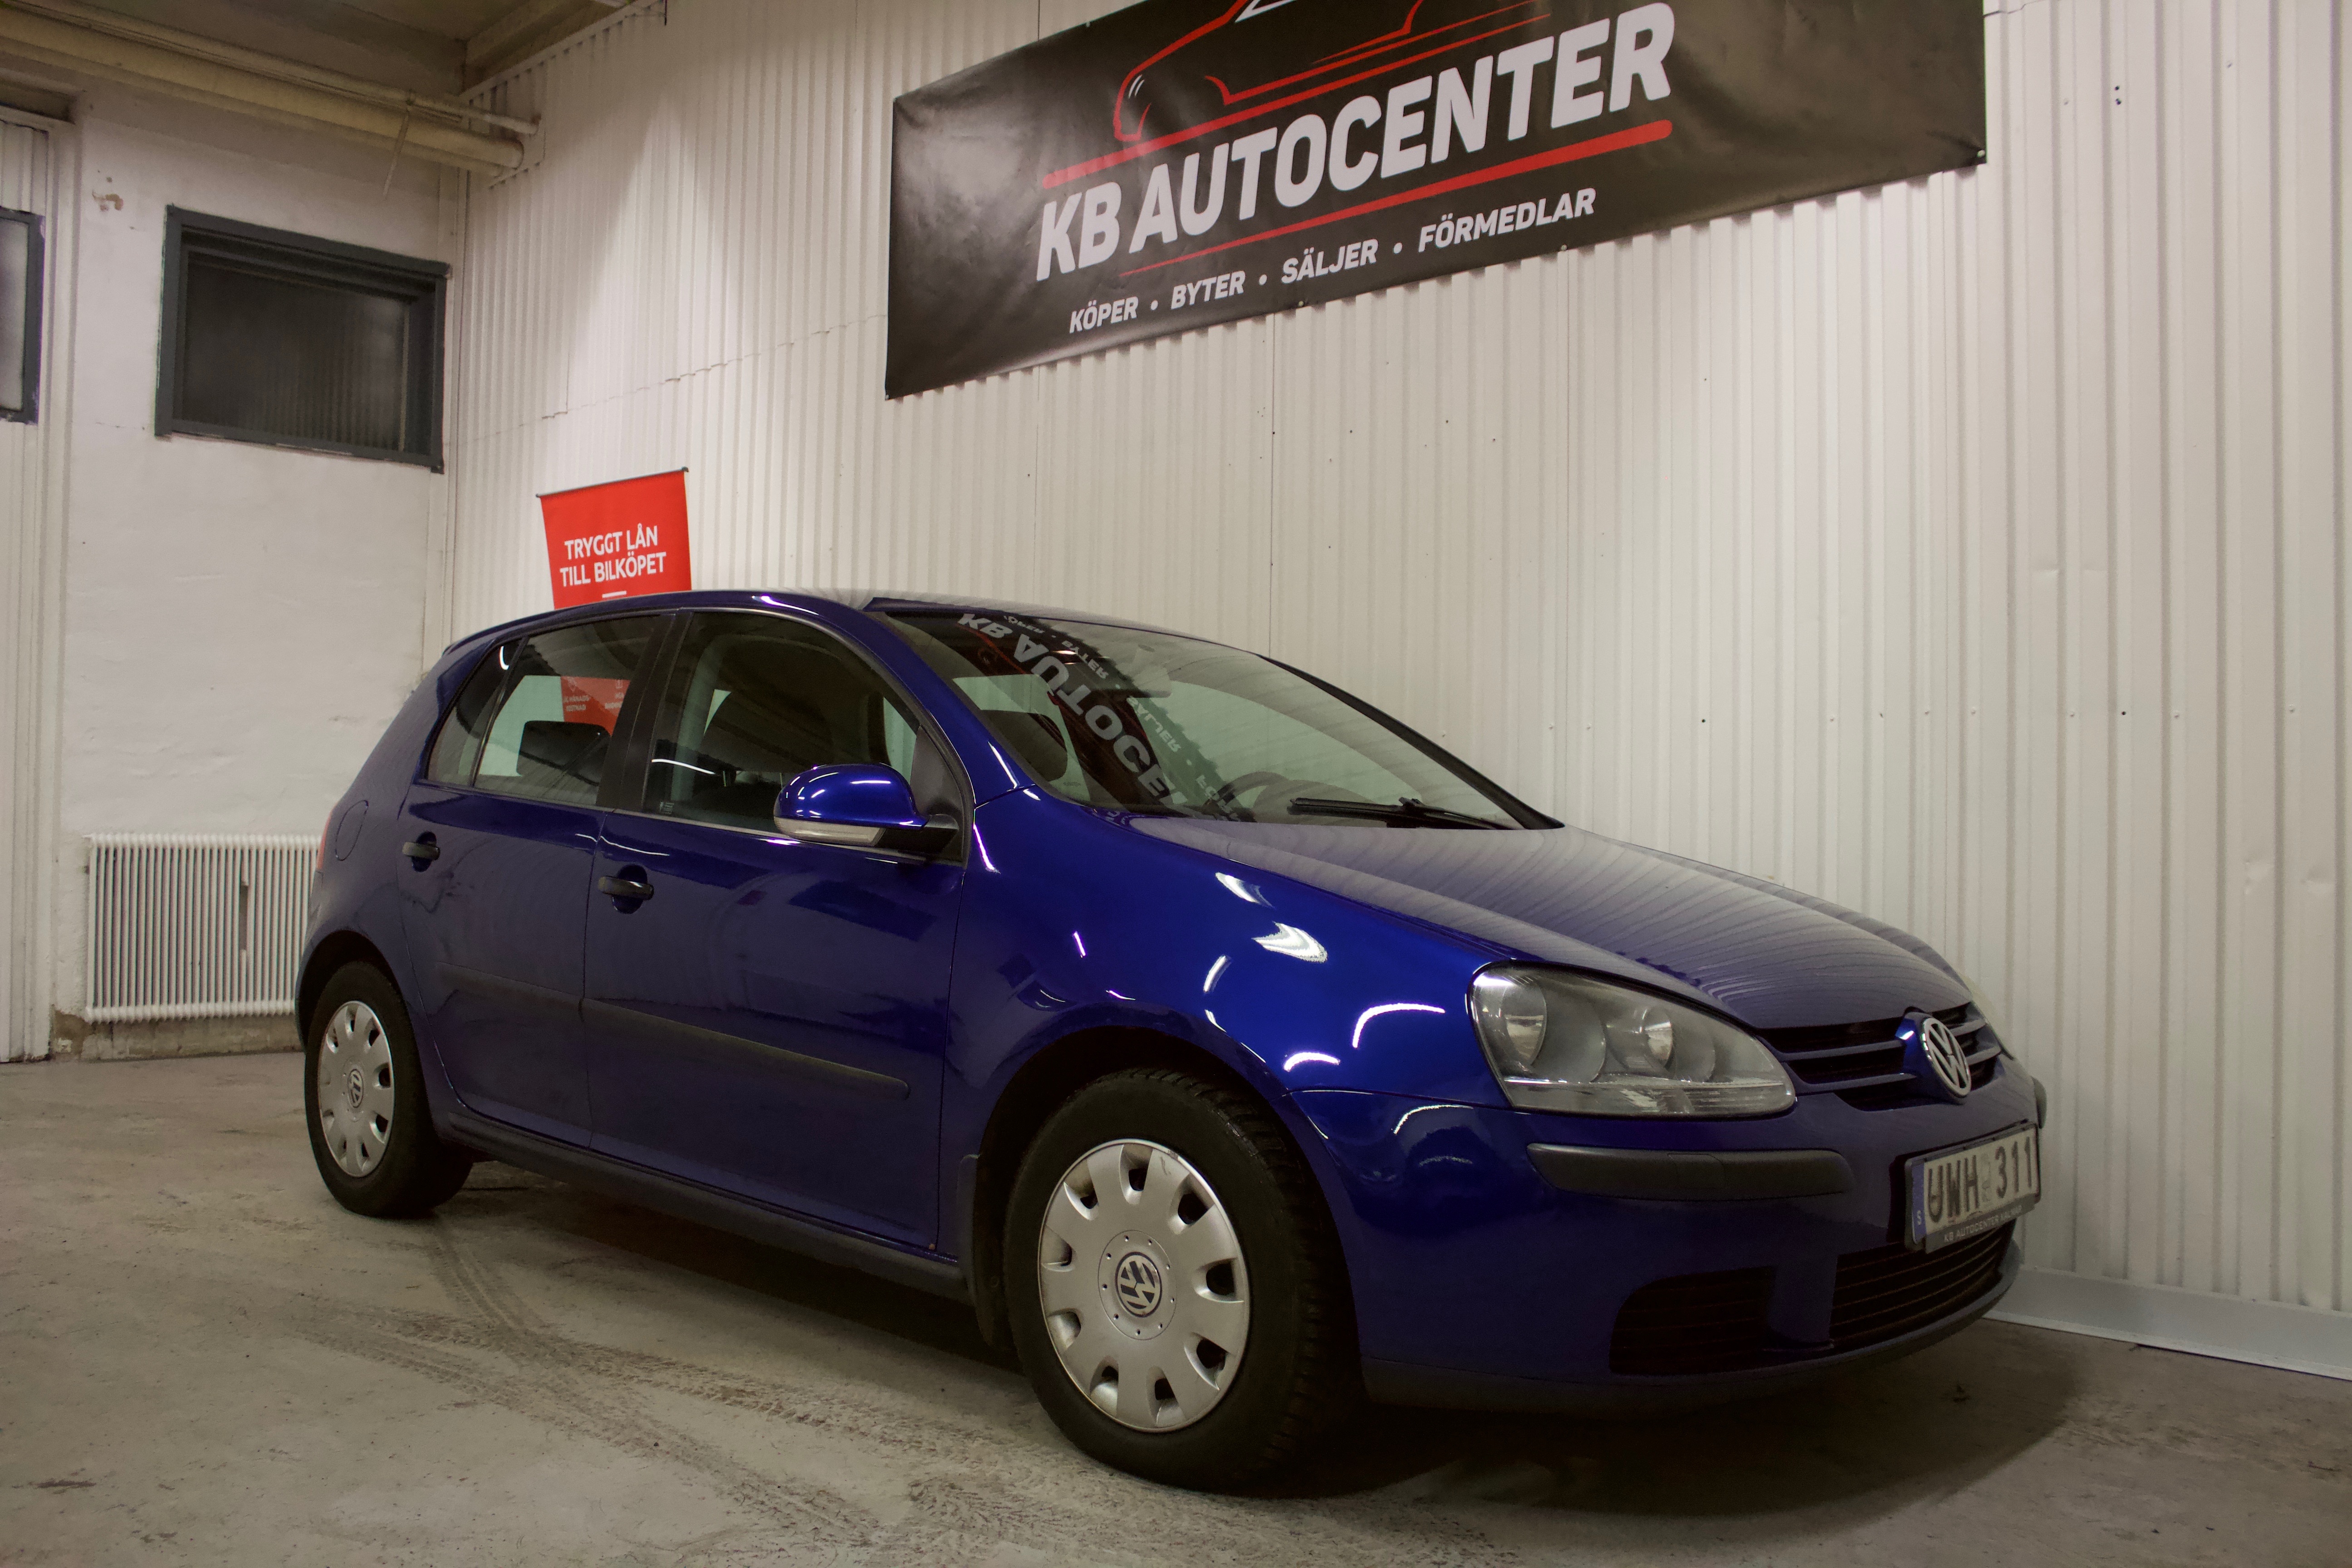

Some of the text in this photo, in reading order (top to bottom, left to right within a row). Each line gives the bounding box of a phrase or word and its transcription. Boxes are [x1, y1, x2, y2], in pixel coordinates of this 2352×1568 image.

[1036, 2, 1675, 281] KB AUTOCENTER
[1069, 188, 1596, 333] KÖPER BYTER SÄLJER FÖRMEDLAR
[559, 551, 667, 587] TILL BILKÖPET
[564, 523, 658, 560] TRYGGT LÅN
[1995, 1136, 2032, 1199] 311
